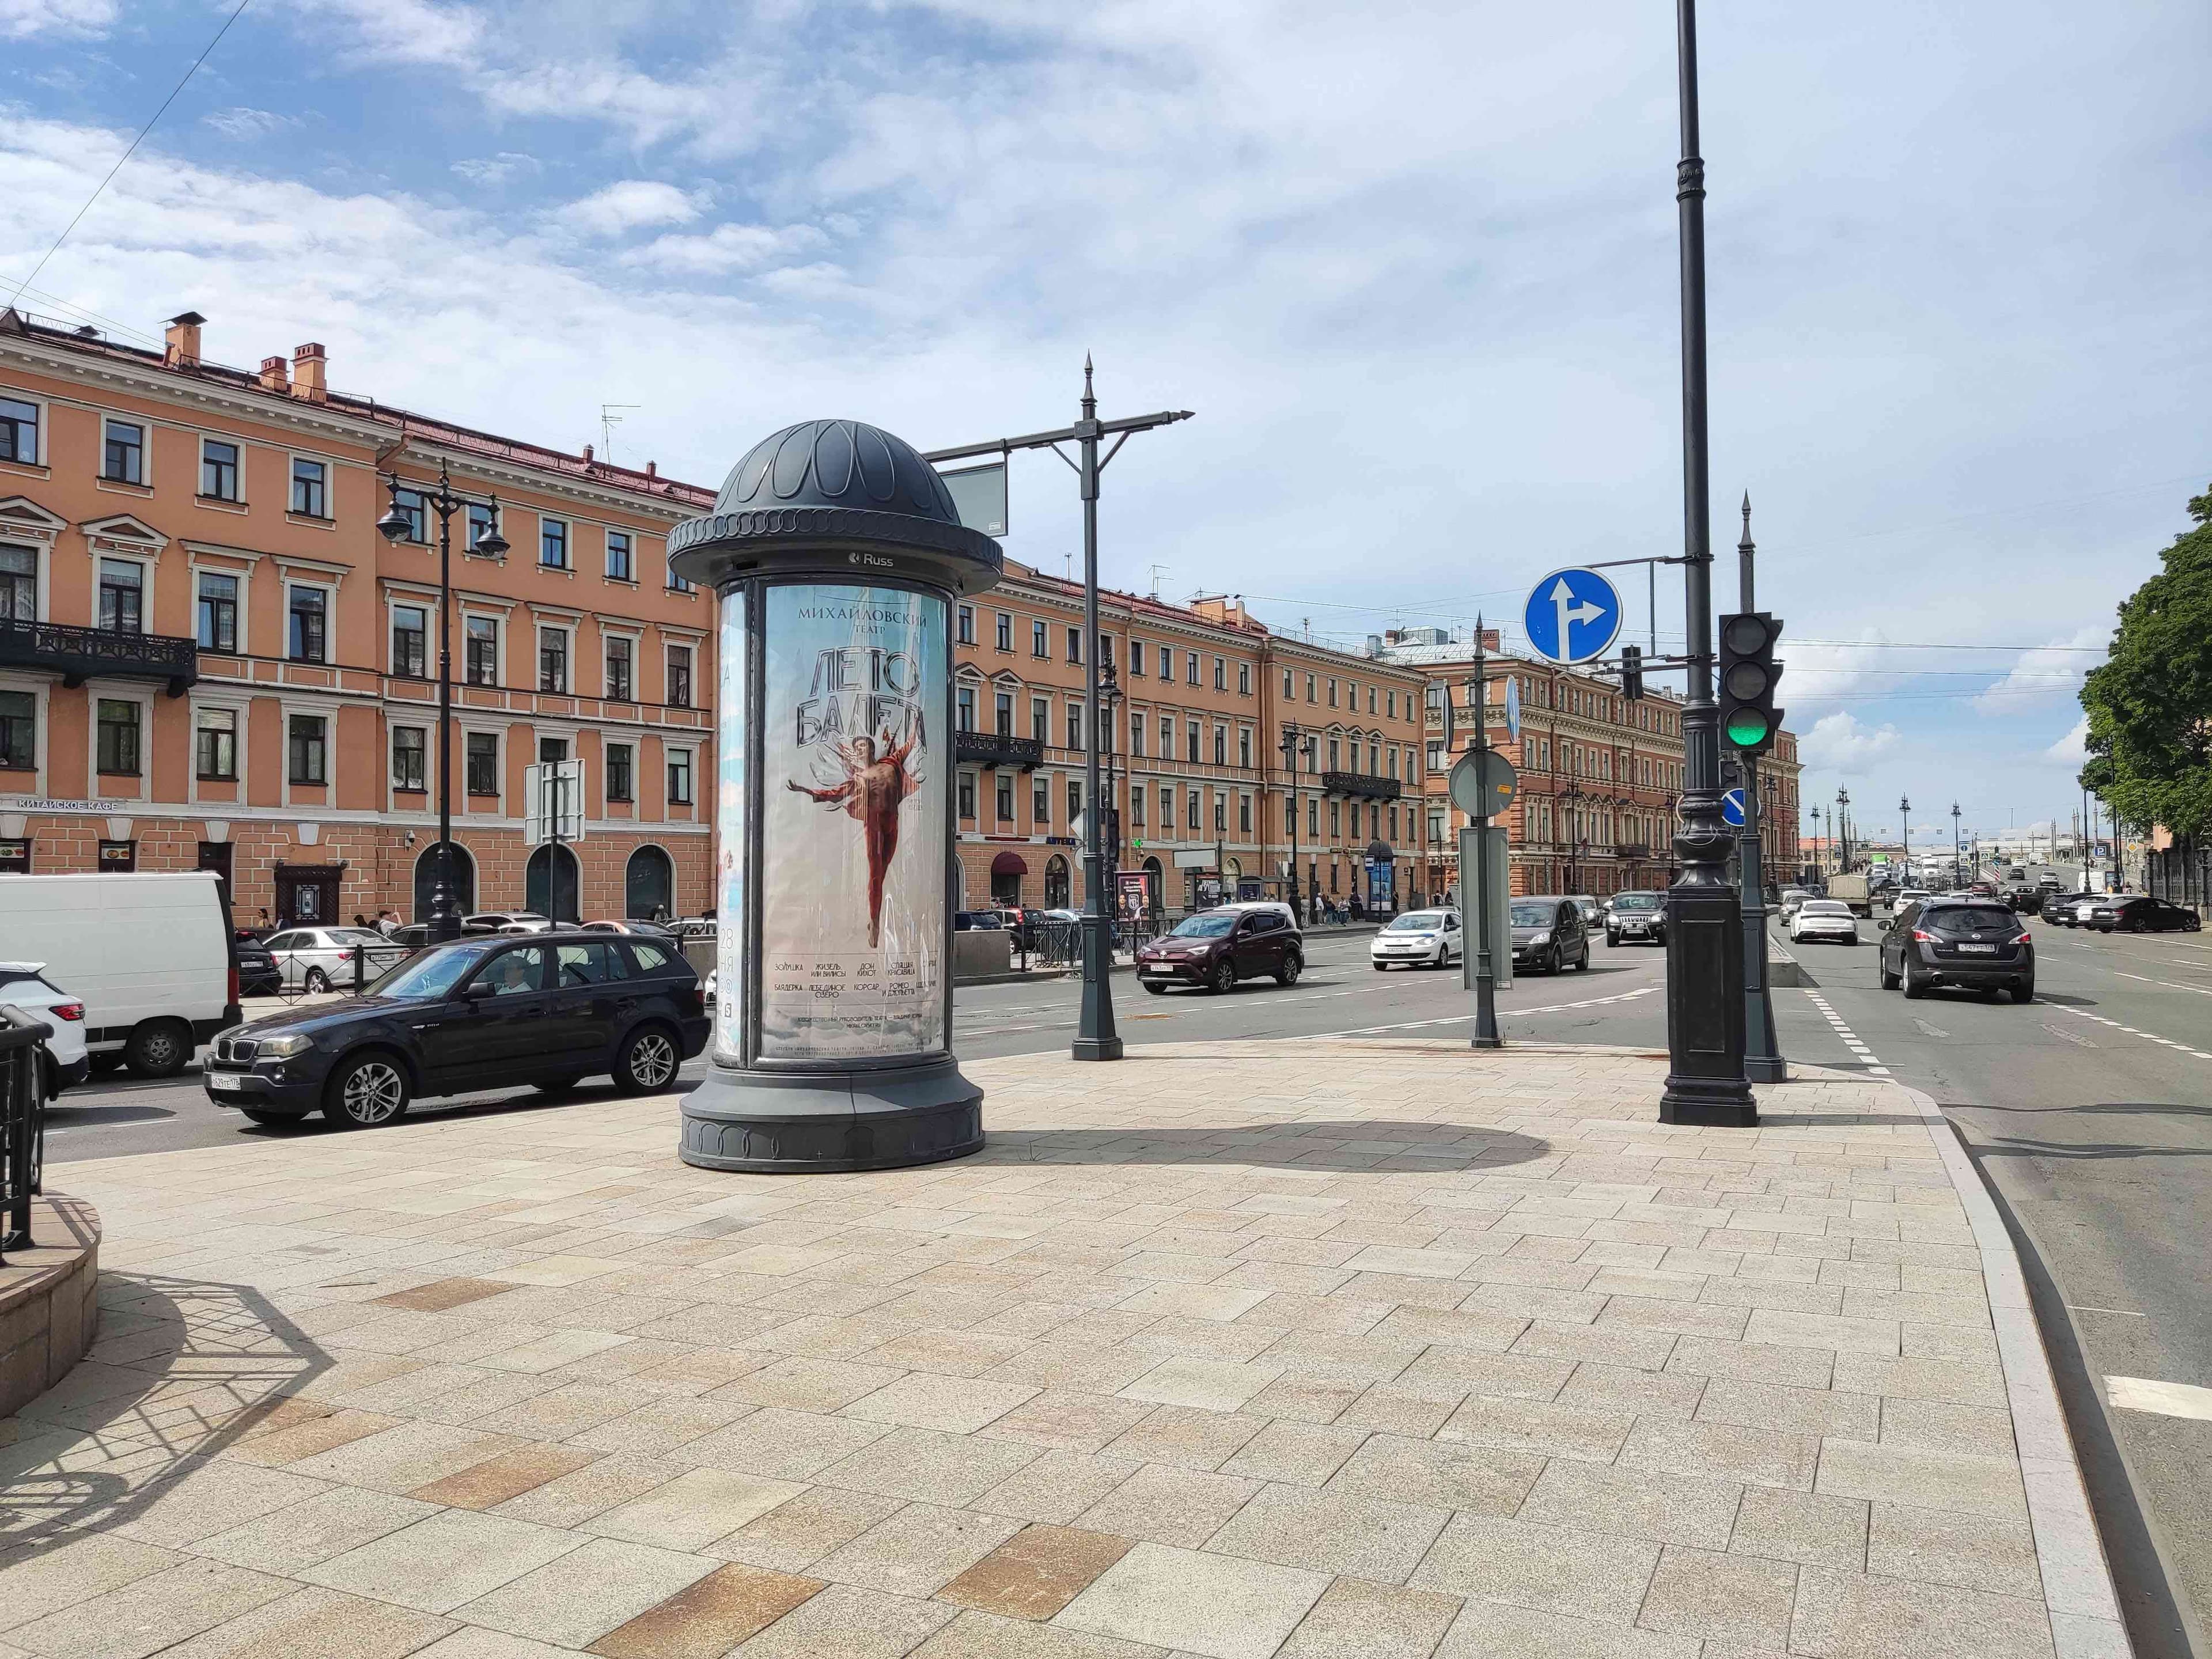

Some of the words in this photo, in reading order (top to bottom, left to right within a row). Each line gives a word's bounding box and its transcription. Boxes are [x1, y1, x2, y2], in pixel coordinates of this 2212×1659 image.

[863, 553, 893, 567] Russ
[798, 606, 927, 627] МИХАЙЛОВСКИЙ
[854, 624, 886, 635] ТЕАТР
[809, 646, 921, 698] ЛЕТО
[88, 802, 118, 810] КАФЕ
[720, 927, 733, 949] 28
[774, 962, 804, 971] ЗОЛУШКА
[854, 983, 880, 991] КОРСАР
[889, 982, 910, 990] РОМЕО
